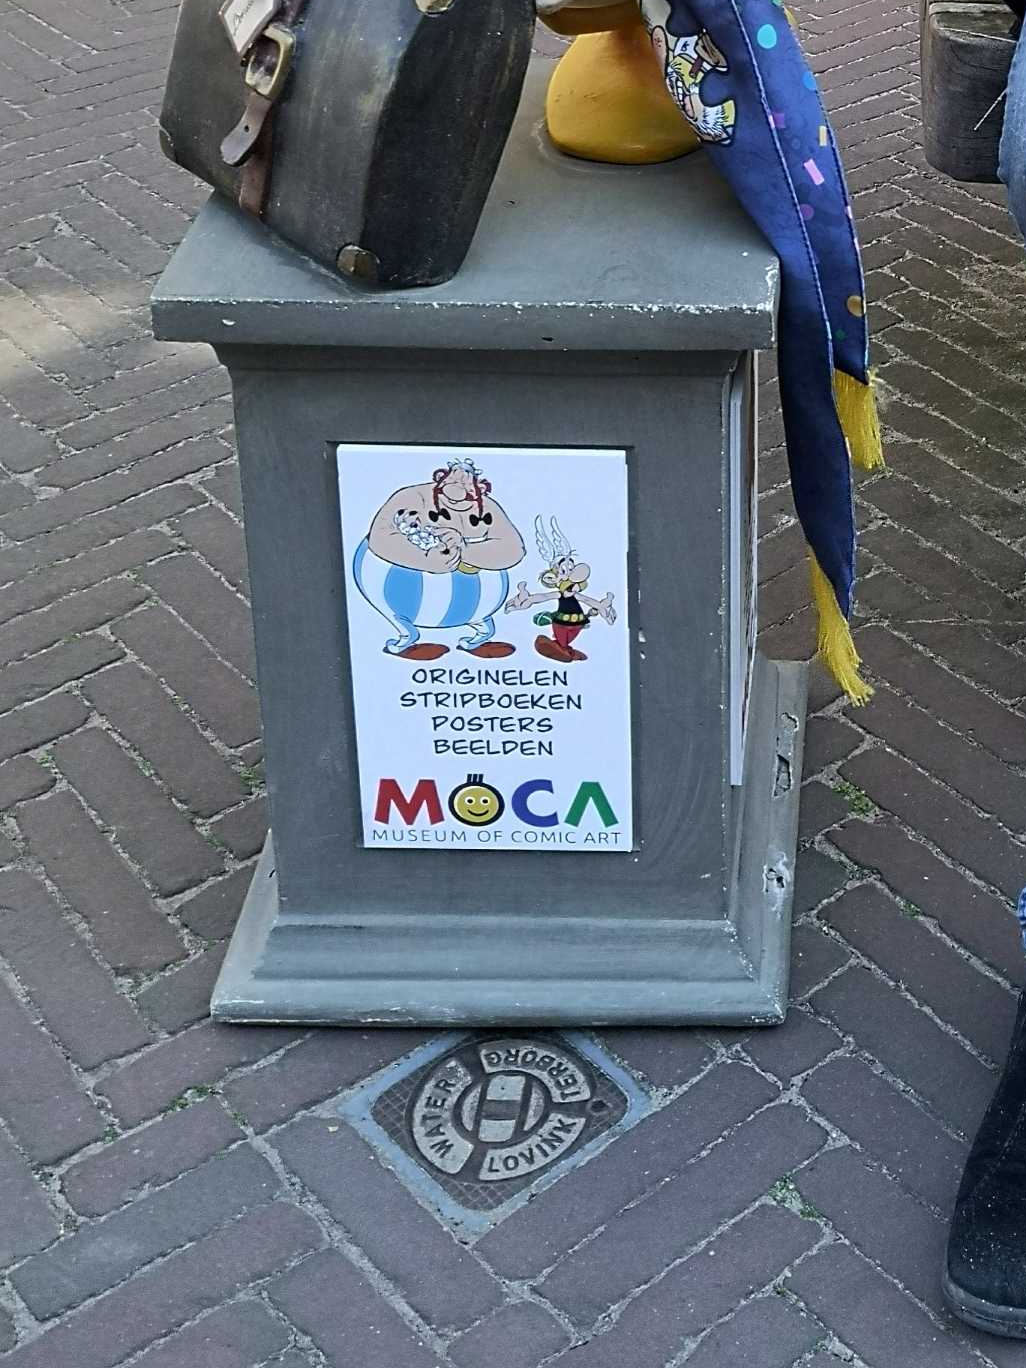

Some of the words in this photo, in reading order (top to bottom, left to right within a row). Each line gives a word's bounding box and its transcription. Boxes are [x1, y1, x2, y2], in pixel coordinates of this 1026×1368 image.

[411, 668, 568, 687] ORIGINELEN
[400, 692, 582, 711] STRIPBOEKEN
[432, 715, 553, 734] POSTERS
[433, 739, 554, 756] BEELDEN
[373, 773, 619, 827] MOCA
[372, 829, 467, 843] MUSEUM
[477, 829, 502, 844] OF
[511, 830, 576, 845] COMIC
[583, 831, 622, 845] ART
[424, 1077, 455, 1159] WATER
[488, 1117, 577, 1174] LOVINK
